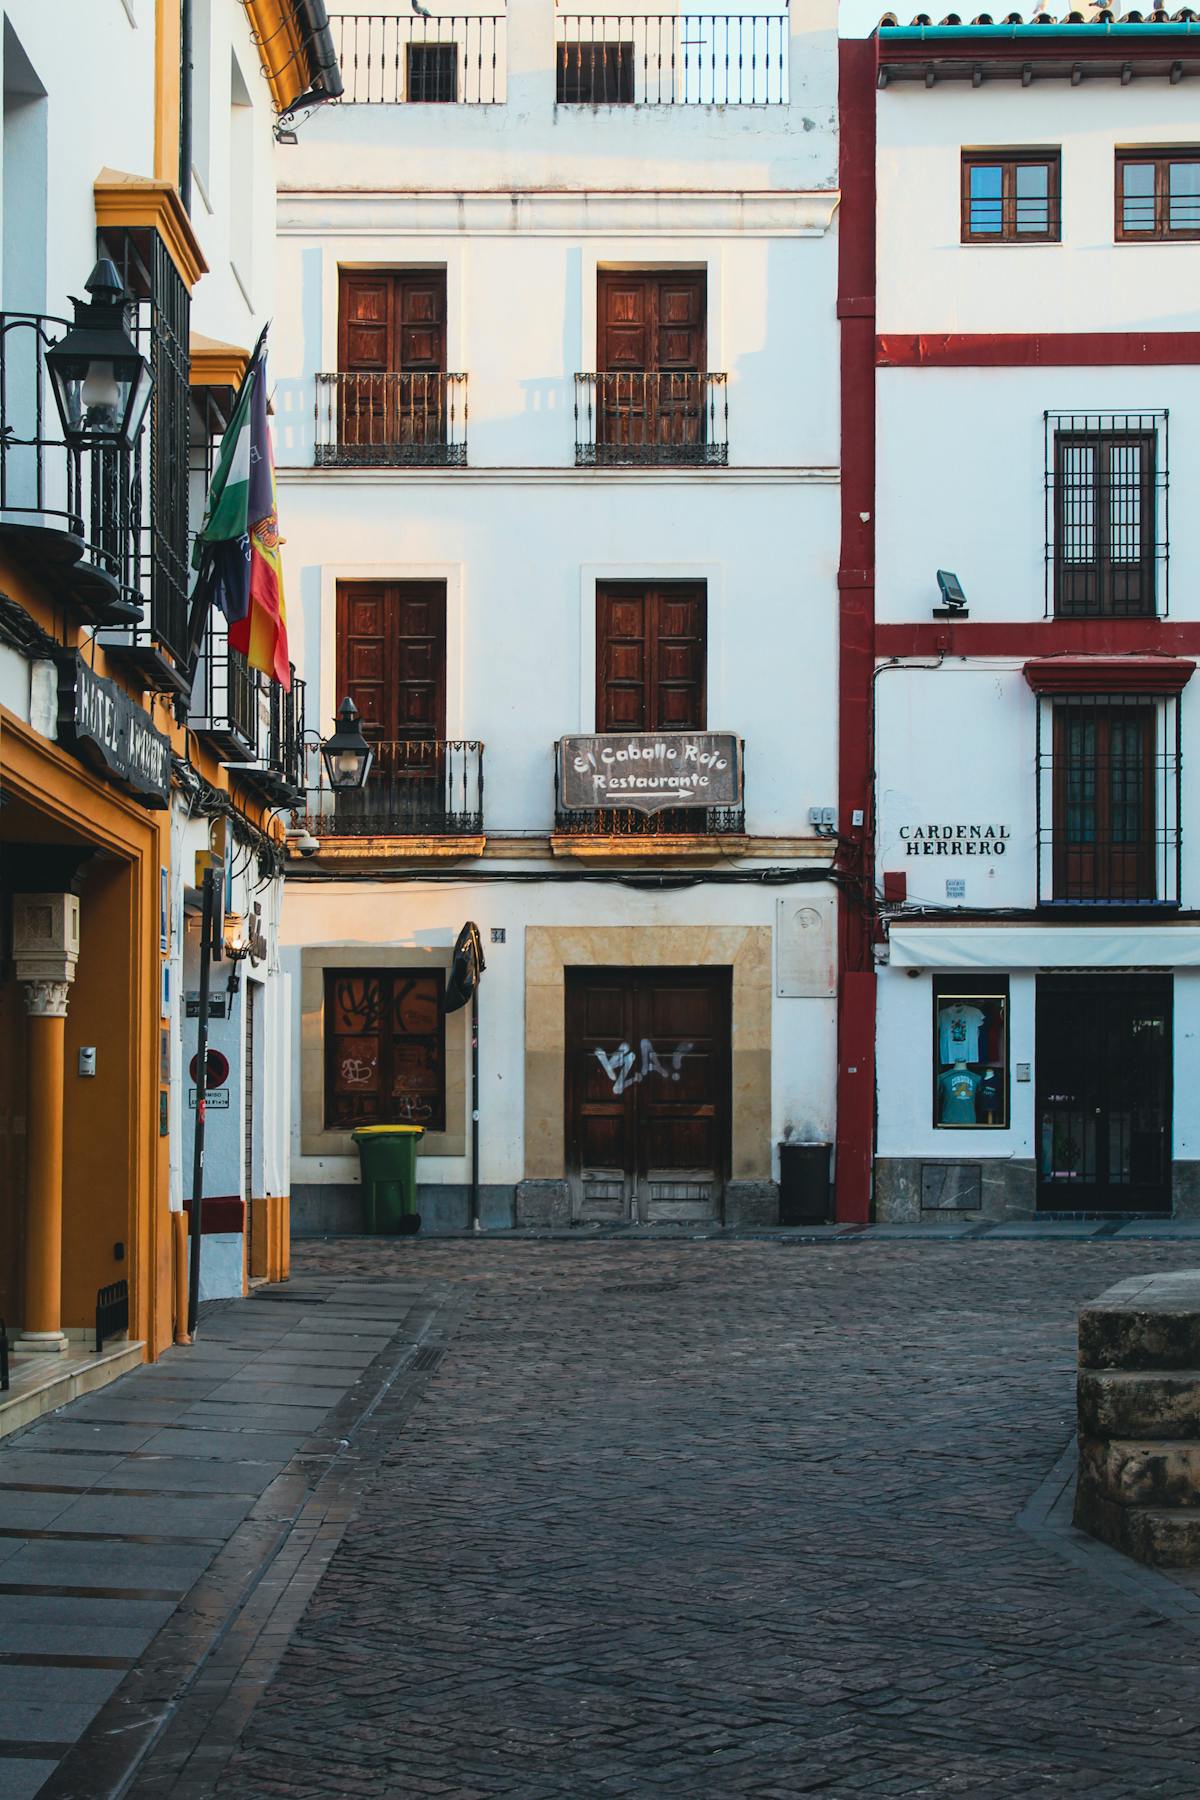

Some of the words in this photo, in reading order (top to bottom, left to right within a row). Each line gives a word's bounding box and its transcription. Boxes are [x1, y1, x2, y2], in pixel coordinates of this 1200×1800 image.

[81, 672, 118, 753] HOTEL
[601, 743, 677, 764] Caballo
[684, 744, 728, 770] Rojo
[592, 773, 710, 789] Restaurante
[899, 825, 1010, 839] CARDENAL
[906, 841, 1006, 855] HERRERO
